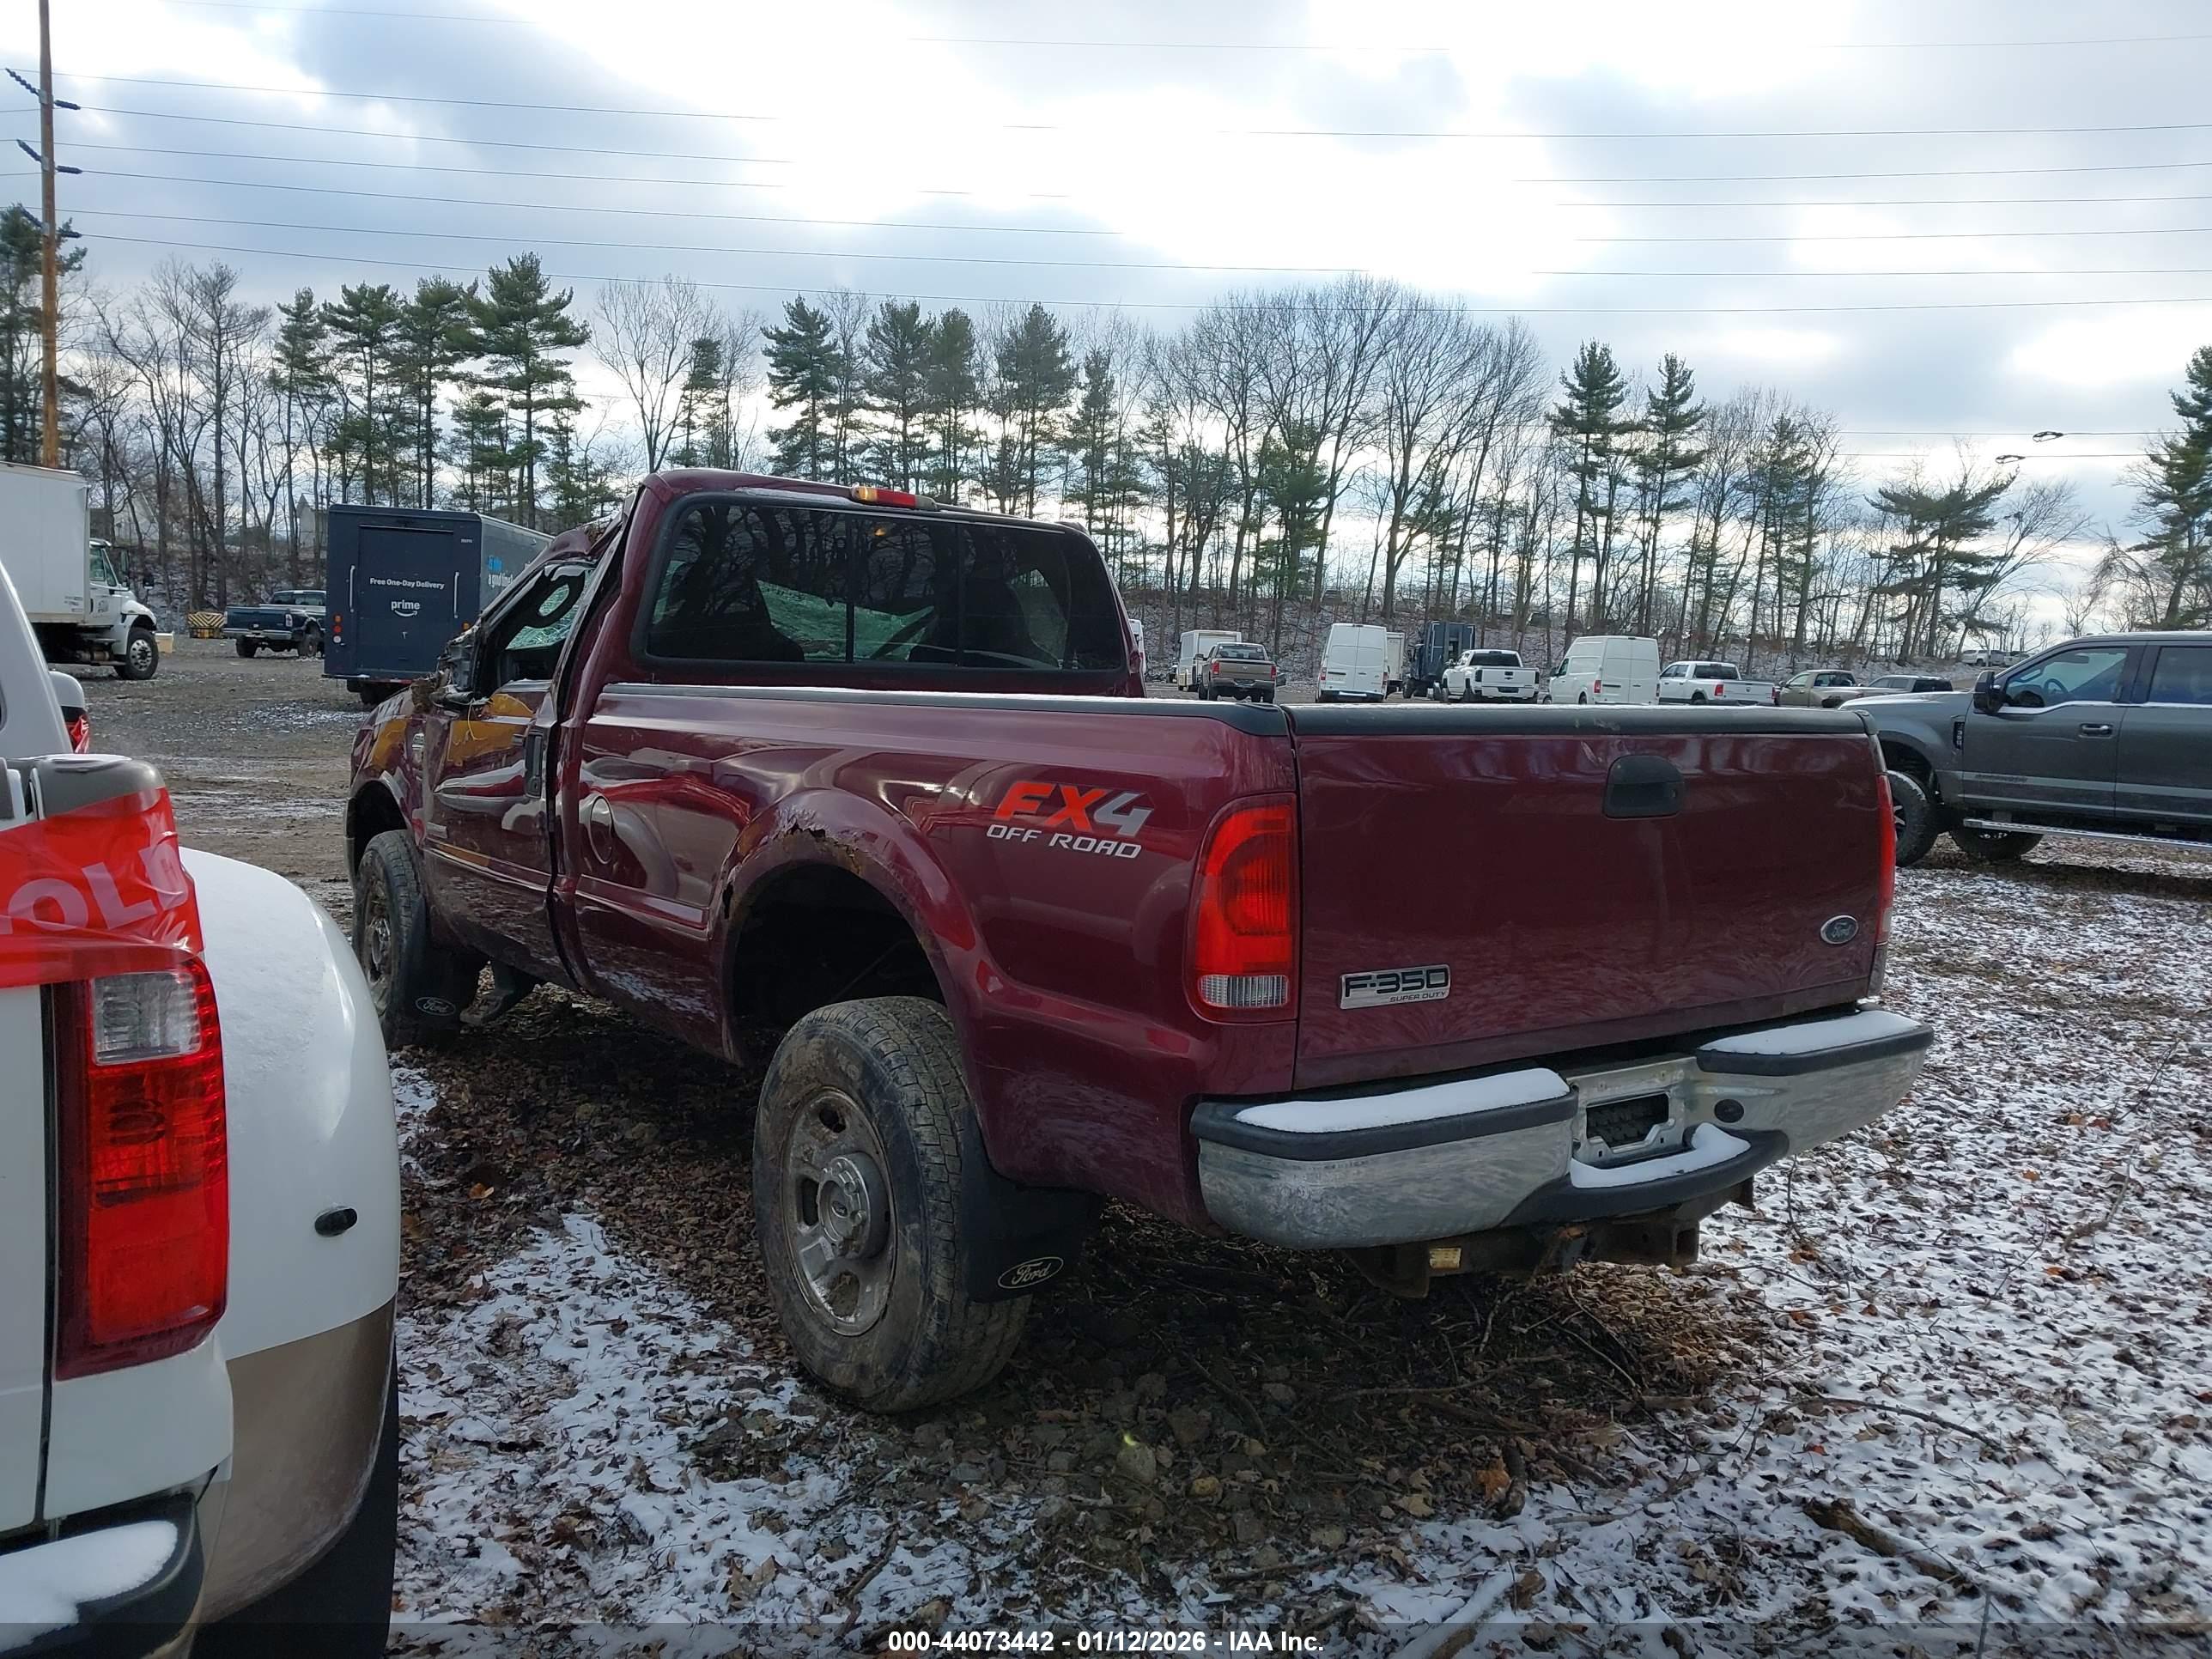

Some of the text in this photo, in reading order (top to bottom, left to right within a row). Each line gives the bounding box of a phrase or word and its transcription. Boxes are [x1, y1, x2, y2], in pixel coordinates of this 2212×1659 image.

[369, 577, 446, 590] Free One-Day Delivery
[391, 599, 421, 611] prime
[994, 781, 1155, 837] FX4
[987, 823, 1142, 859] OFF ROAD
[1345, 967, 1449, 998] F-350
[1389, 994, 1420, 1003] SUPER
[1012, 1261, 1052, 1285] Ford
